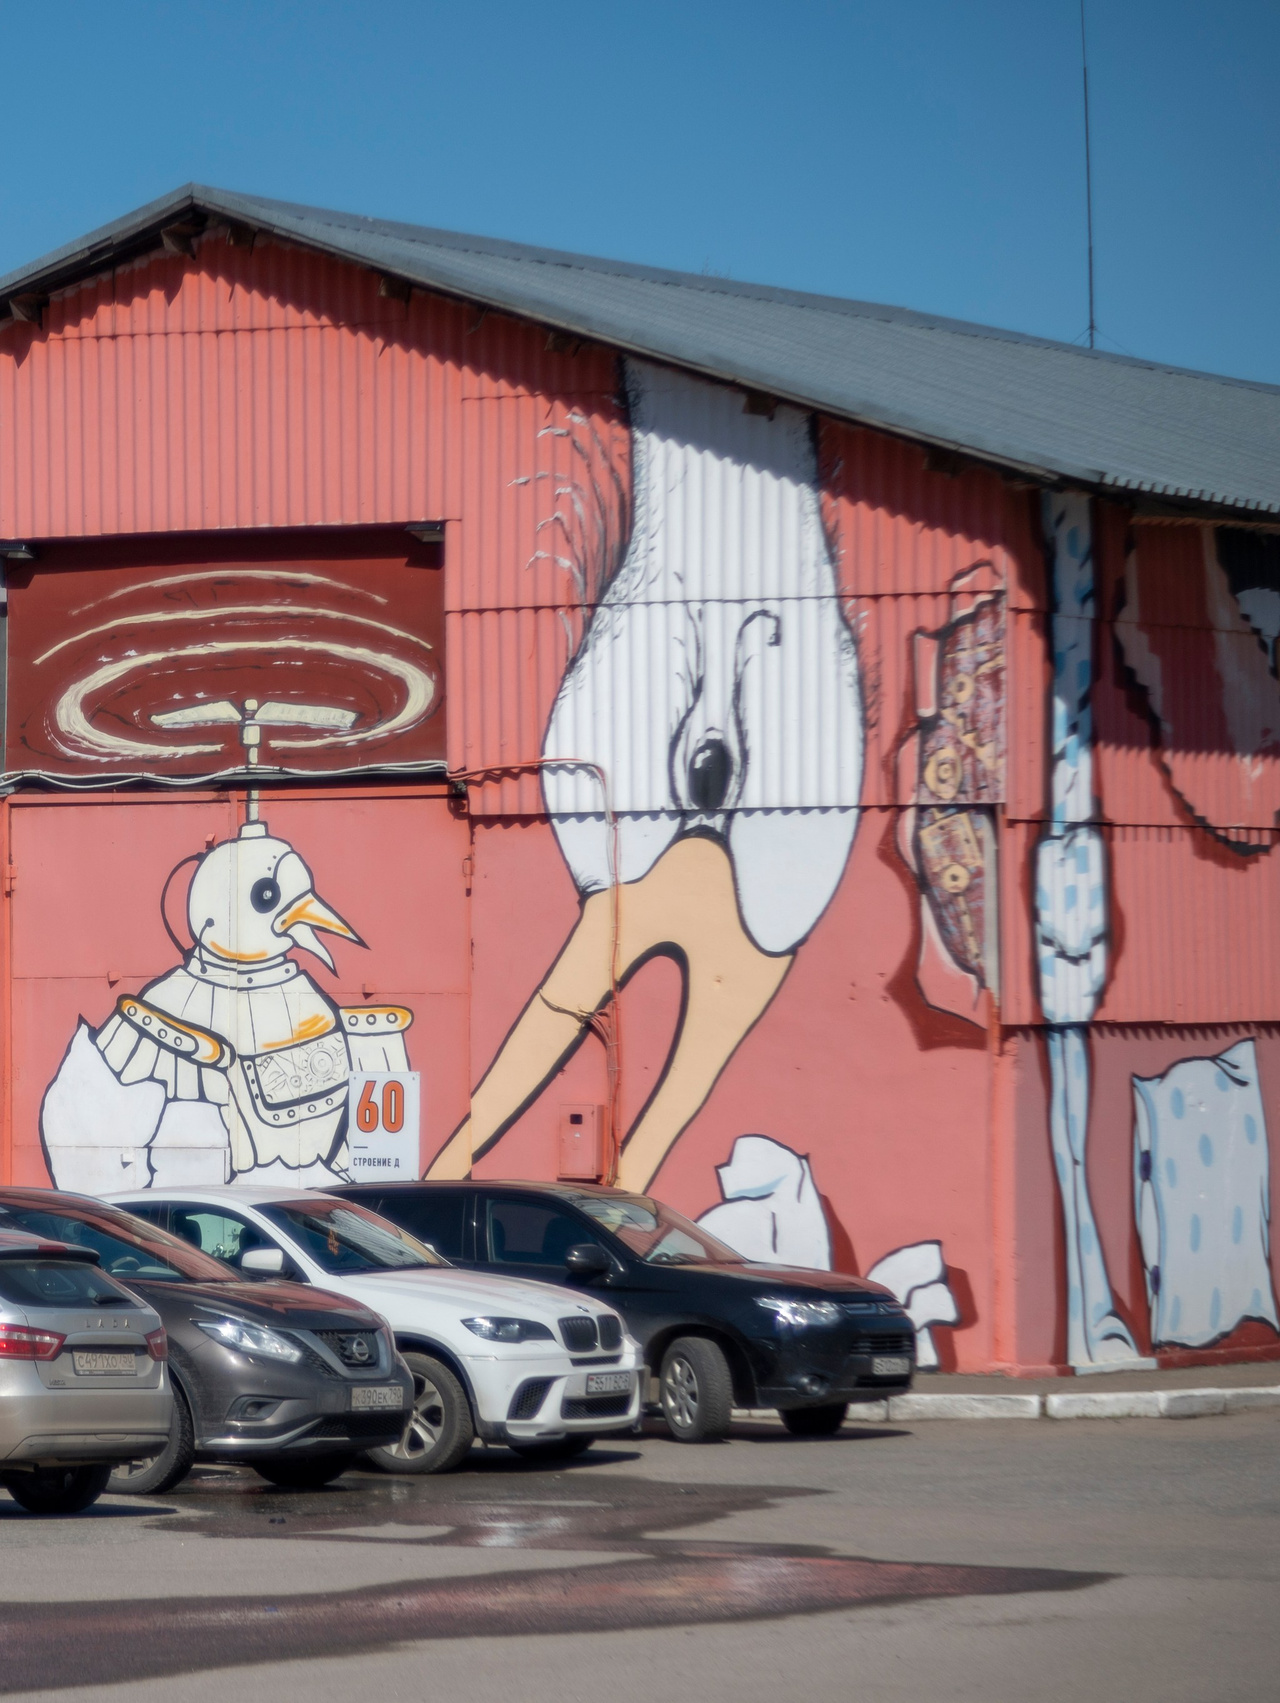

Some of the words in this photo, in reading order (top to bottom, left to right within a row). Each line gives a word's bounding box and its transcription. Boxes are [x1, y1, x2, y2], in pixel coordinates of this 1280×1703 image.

[356, 1080, 404, 1133] 60
[353, 1157, 391, 1167] СТРОЕНИЕ
[394, 1158, 400, 1168] Д
[85, 1317, 130, 1328] LADA
